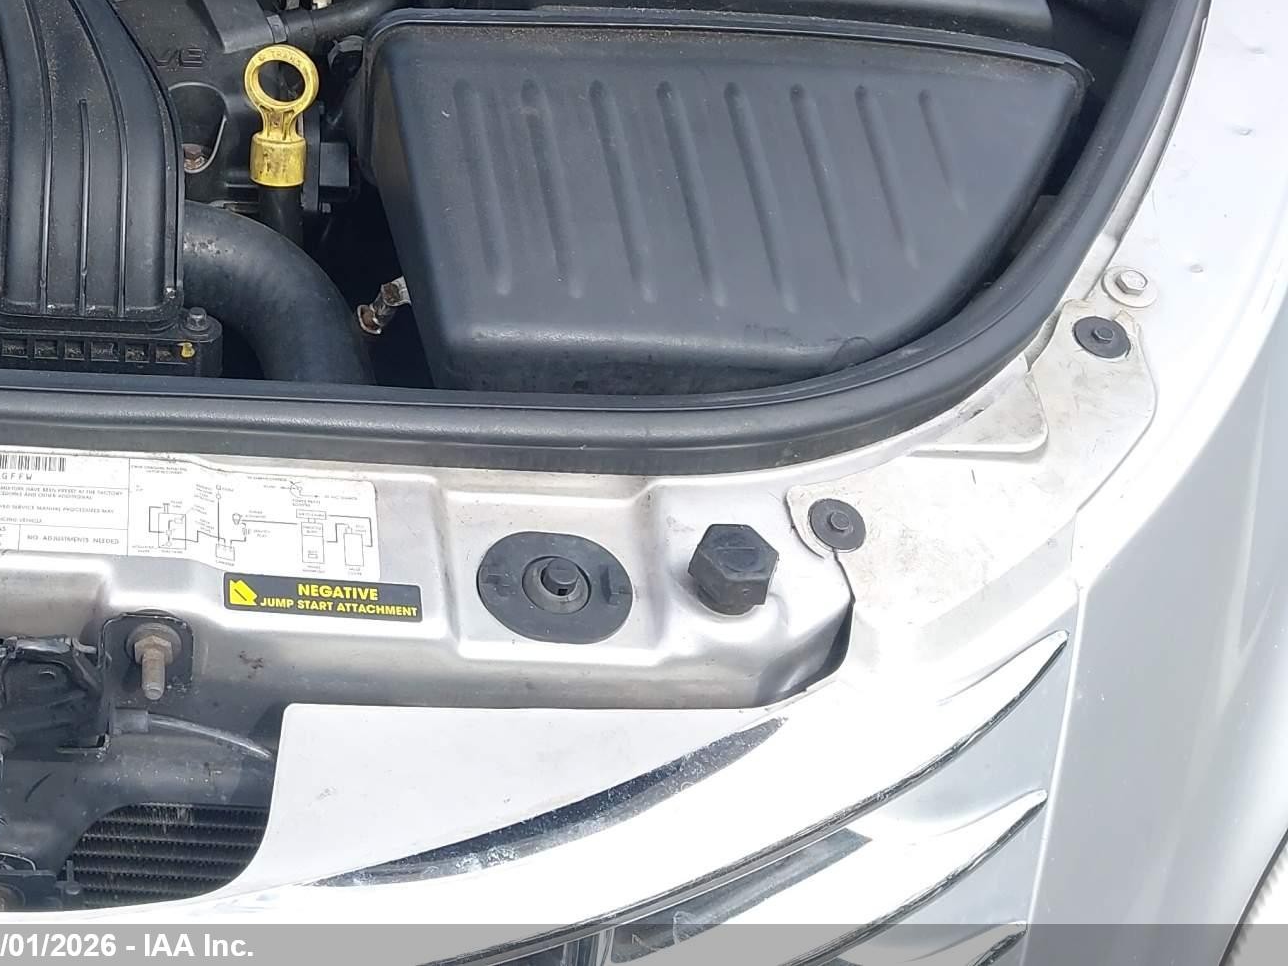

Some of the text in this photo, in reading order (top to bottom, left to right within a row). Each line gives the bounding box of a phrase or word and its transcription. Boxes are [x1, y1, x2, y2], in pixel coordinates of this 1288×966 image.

[297, 583, 380, 602] NEGATIVE
[260, 597, 418, 617] JUMP START ATTACHMENT
